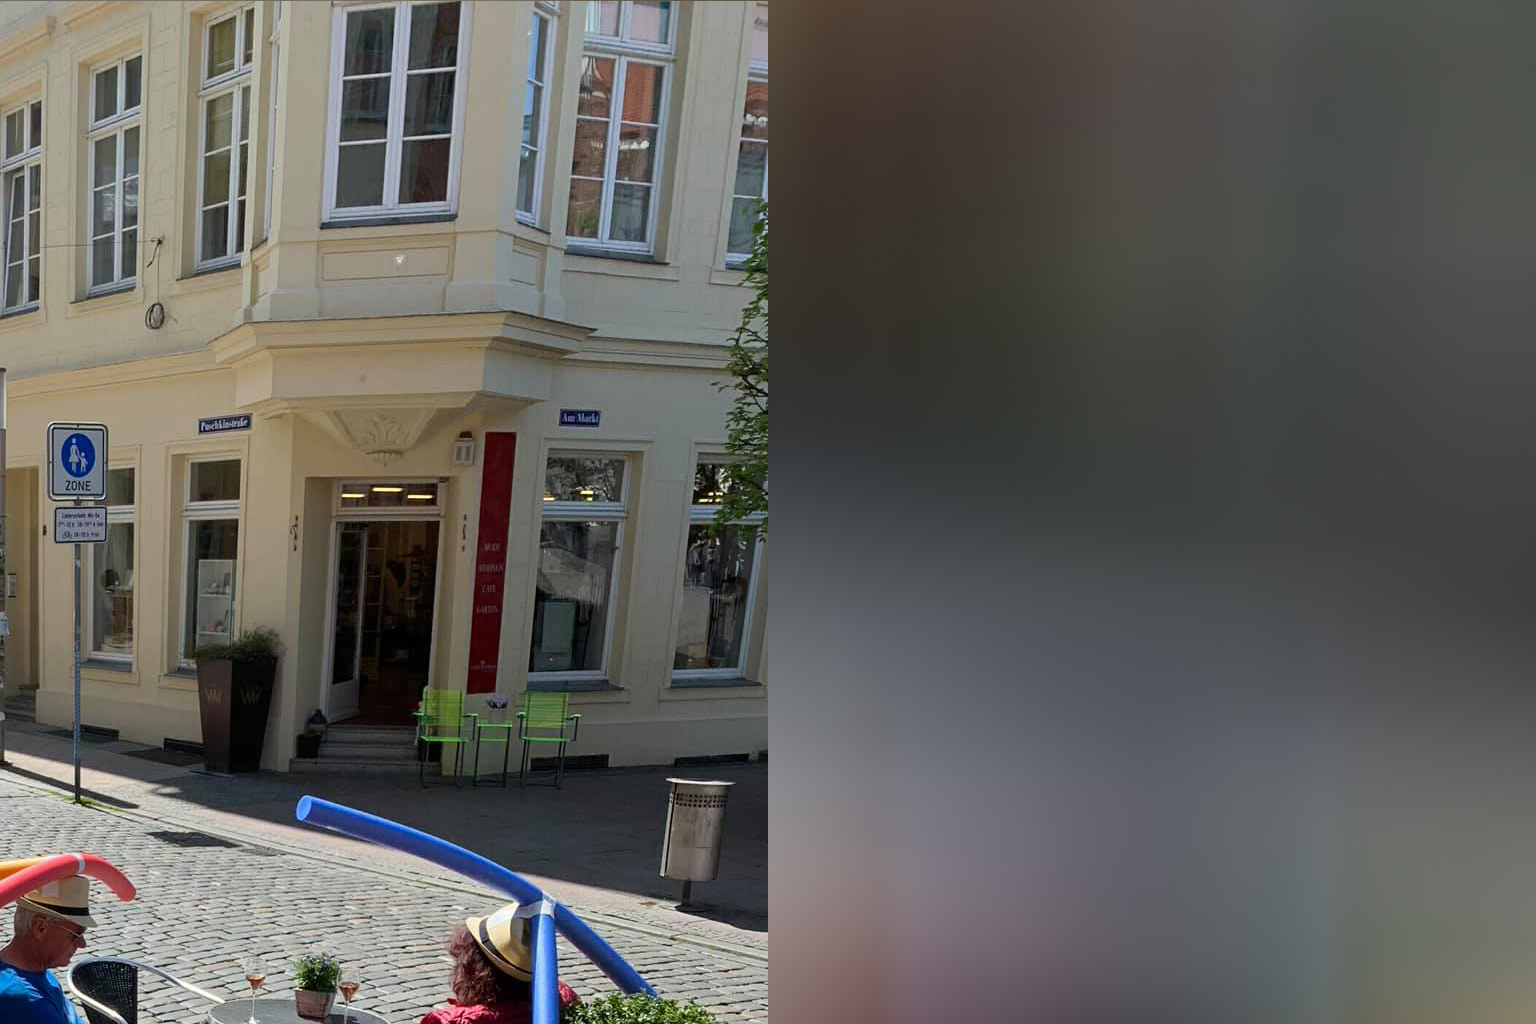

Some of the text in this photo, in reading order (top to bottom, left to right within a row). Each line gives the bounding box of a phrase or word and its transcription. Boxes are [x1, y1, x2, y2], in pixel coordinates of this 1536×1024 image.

[564, 412, 599, 423] Am Markt
[201, 416, 249, 431] Puschkinstraße
[65, 480, 92, 491] ZONE
